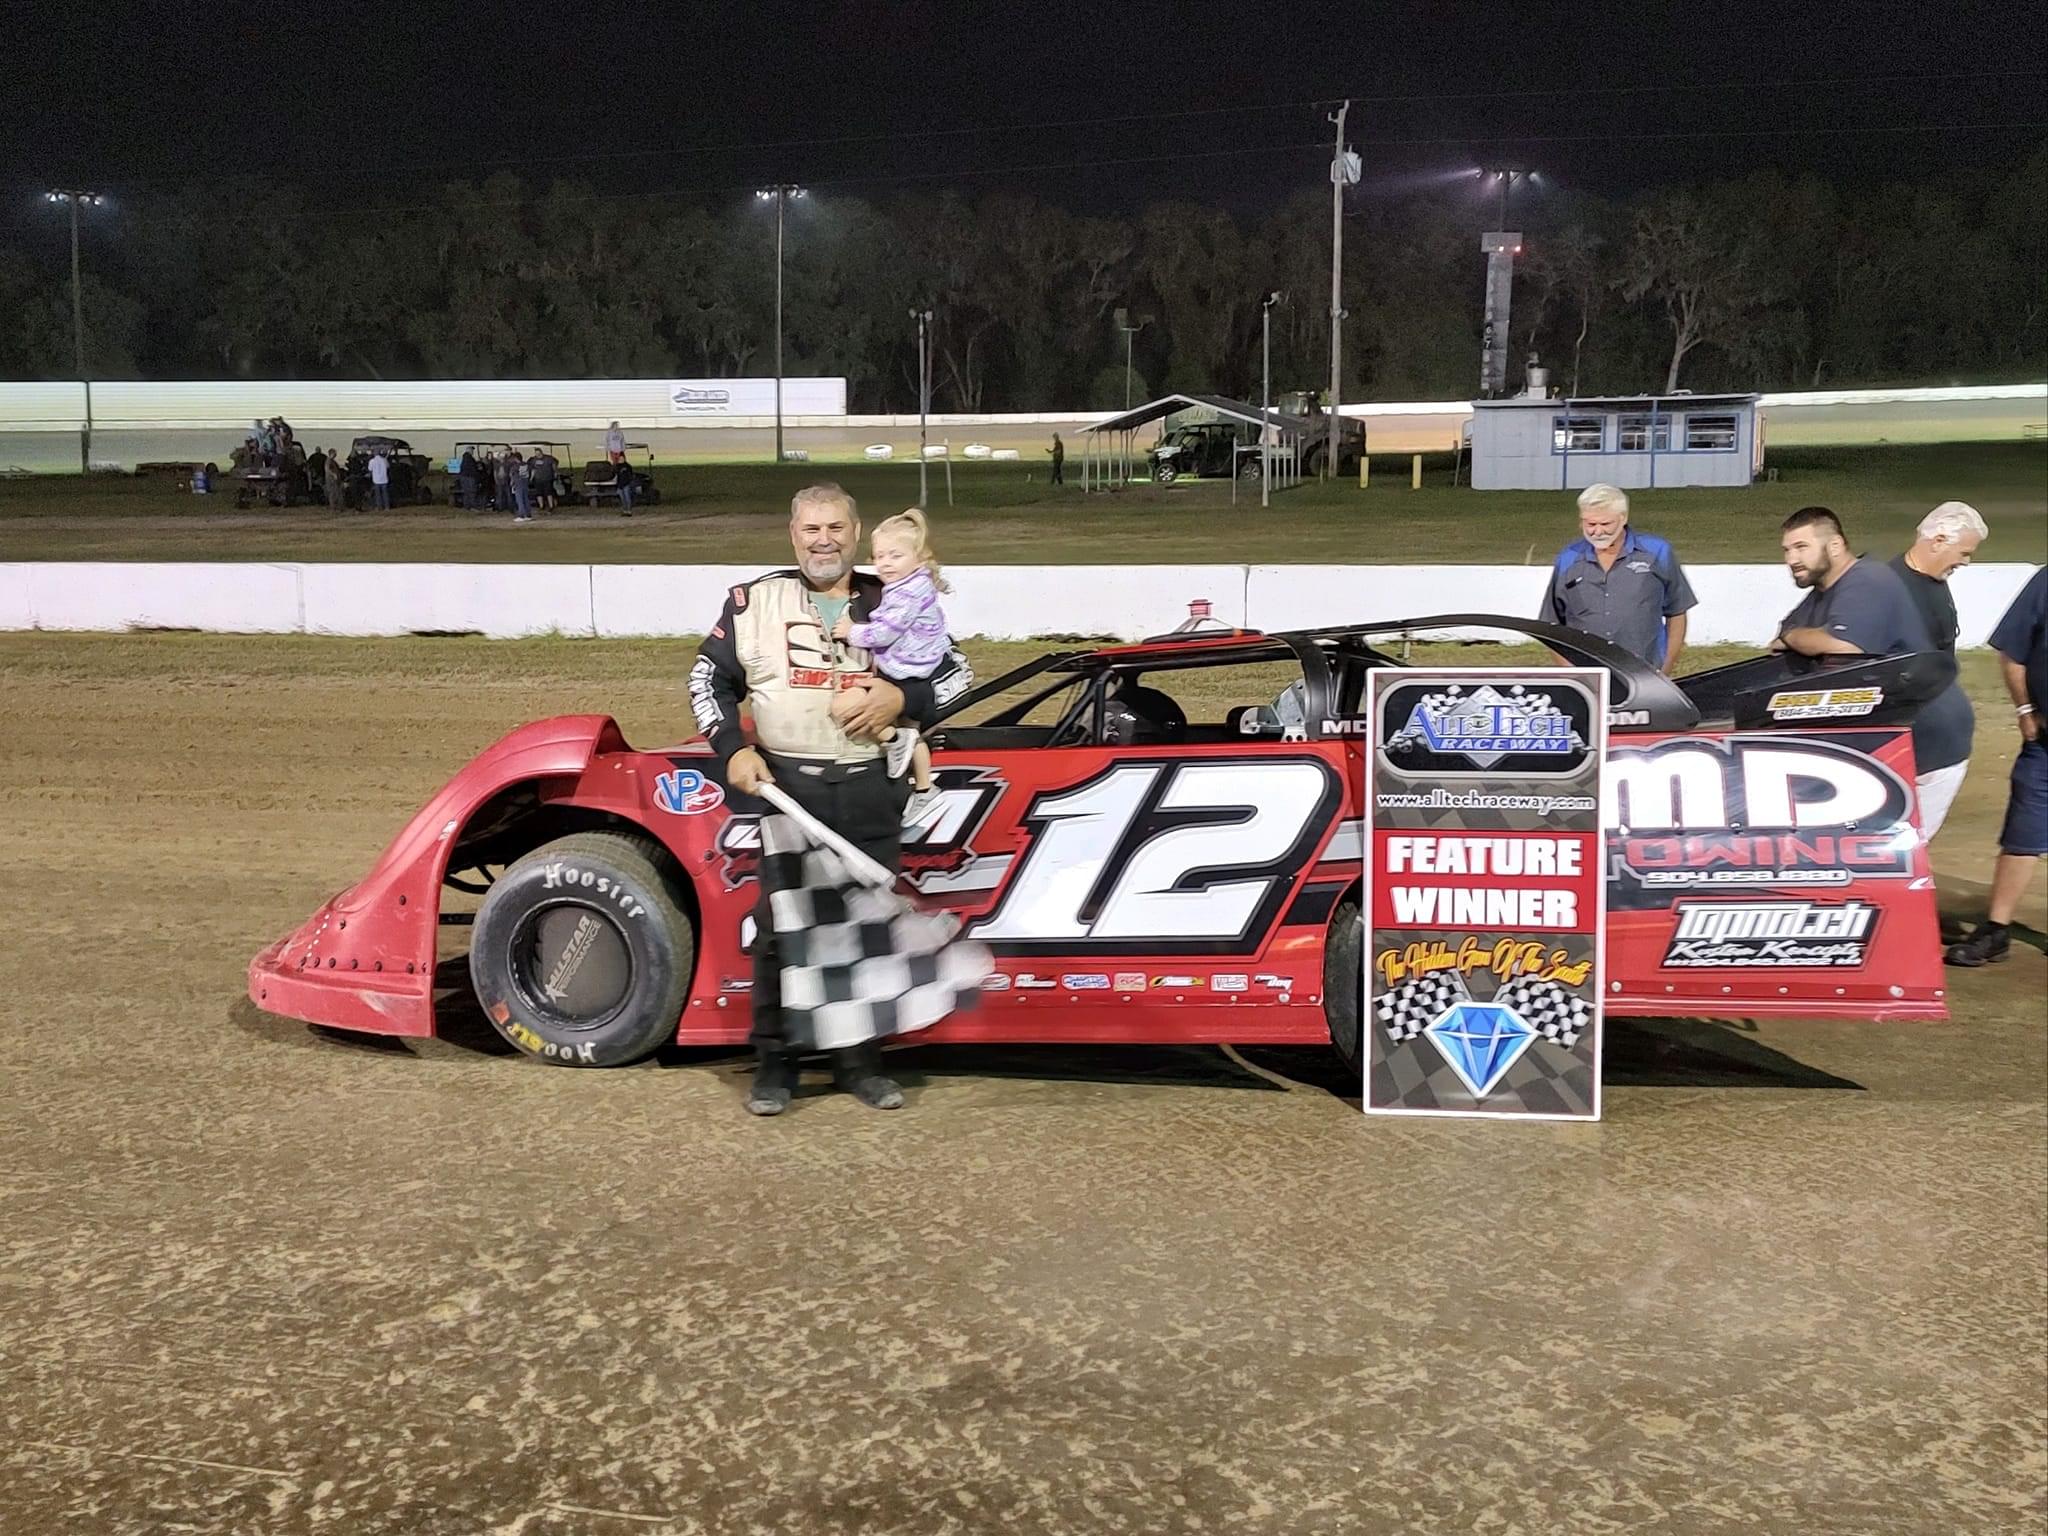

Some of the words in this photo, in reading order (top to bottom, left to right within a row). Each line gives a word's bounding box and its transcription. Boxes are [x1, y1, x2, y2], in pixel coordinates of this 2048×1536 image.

[1439, 737, 1562, 751] RACEWAY
[655, 769, 705, 813] VP
[1376, 789, 1596, 816] www.alltechraceway.com
[967, 763, 1325, 940] 12
[1387, 836, 1584, 877] FEATURE
[1605, 835, 1897, 867] OWING
[542, 863, 645, 918] Hoosier
[1390, 886, 1579, 928] WINNER
[548, 914, 591, 988] ALLSTAR
